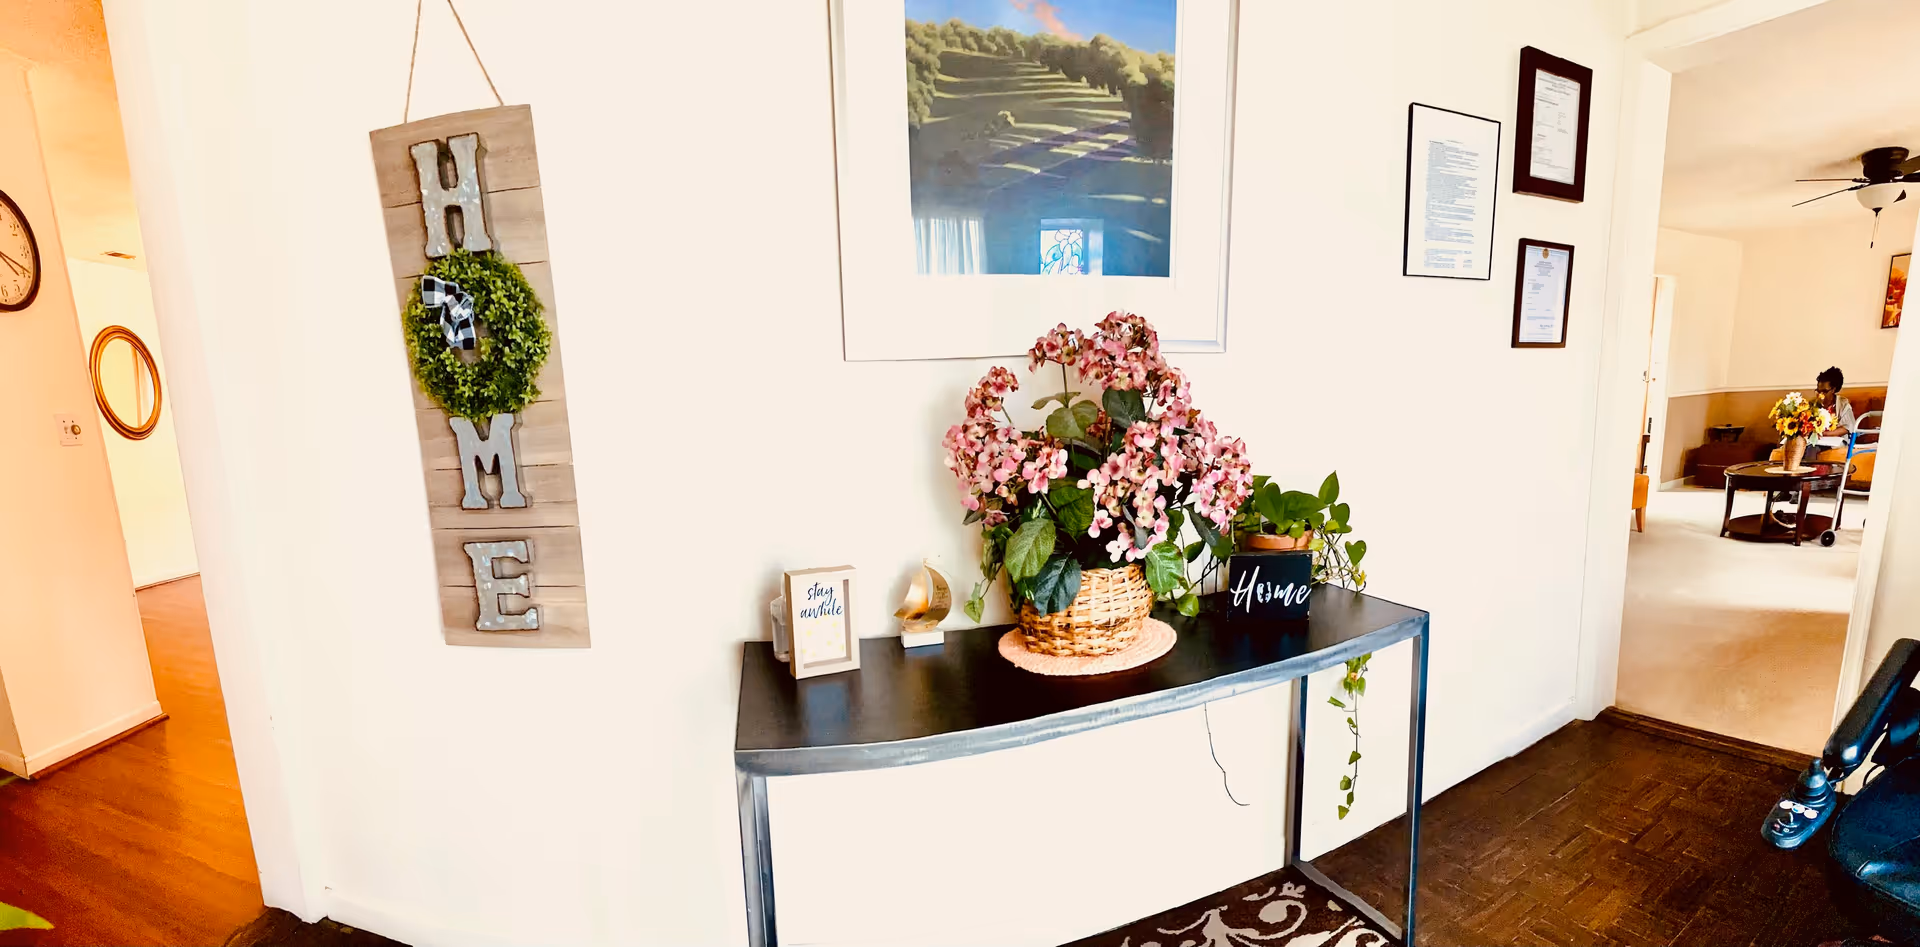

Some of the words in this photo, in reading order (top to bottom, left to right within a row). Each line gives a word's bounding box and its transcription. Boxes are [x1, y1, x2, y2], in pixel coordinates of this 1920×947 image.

[1, 284, 8, 297] 6
[807, 581, 834, 602] stay
[1230, 565, 1312, 613] Home
[800, 599, 843, 619] awhile
